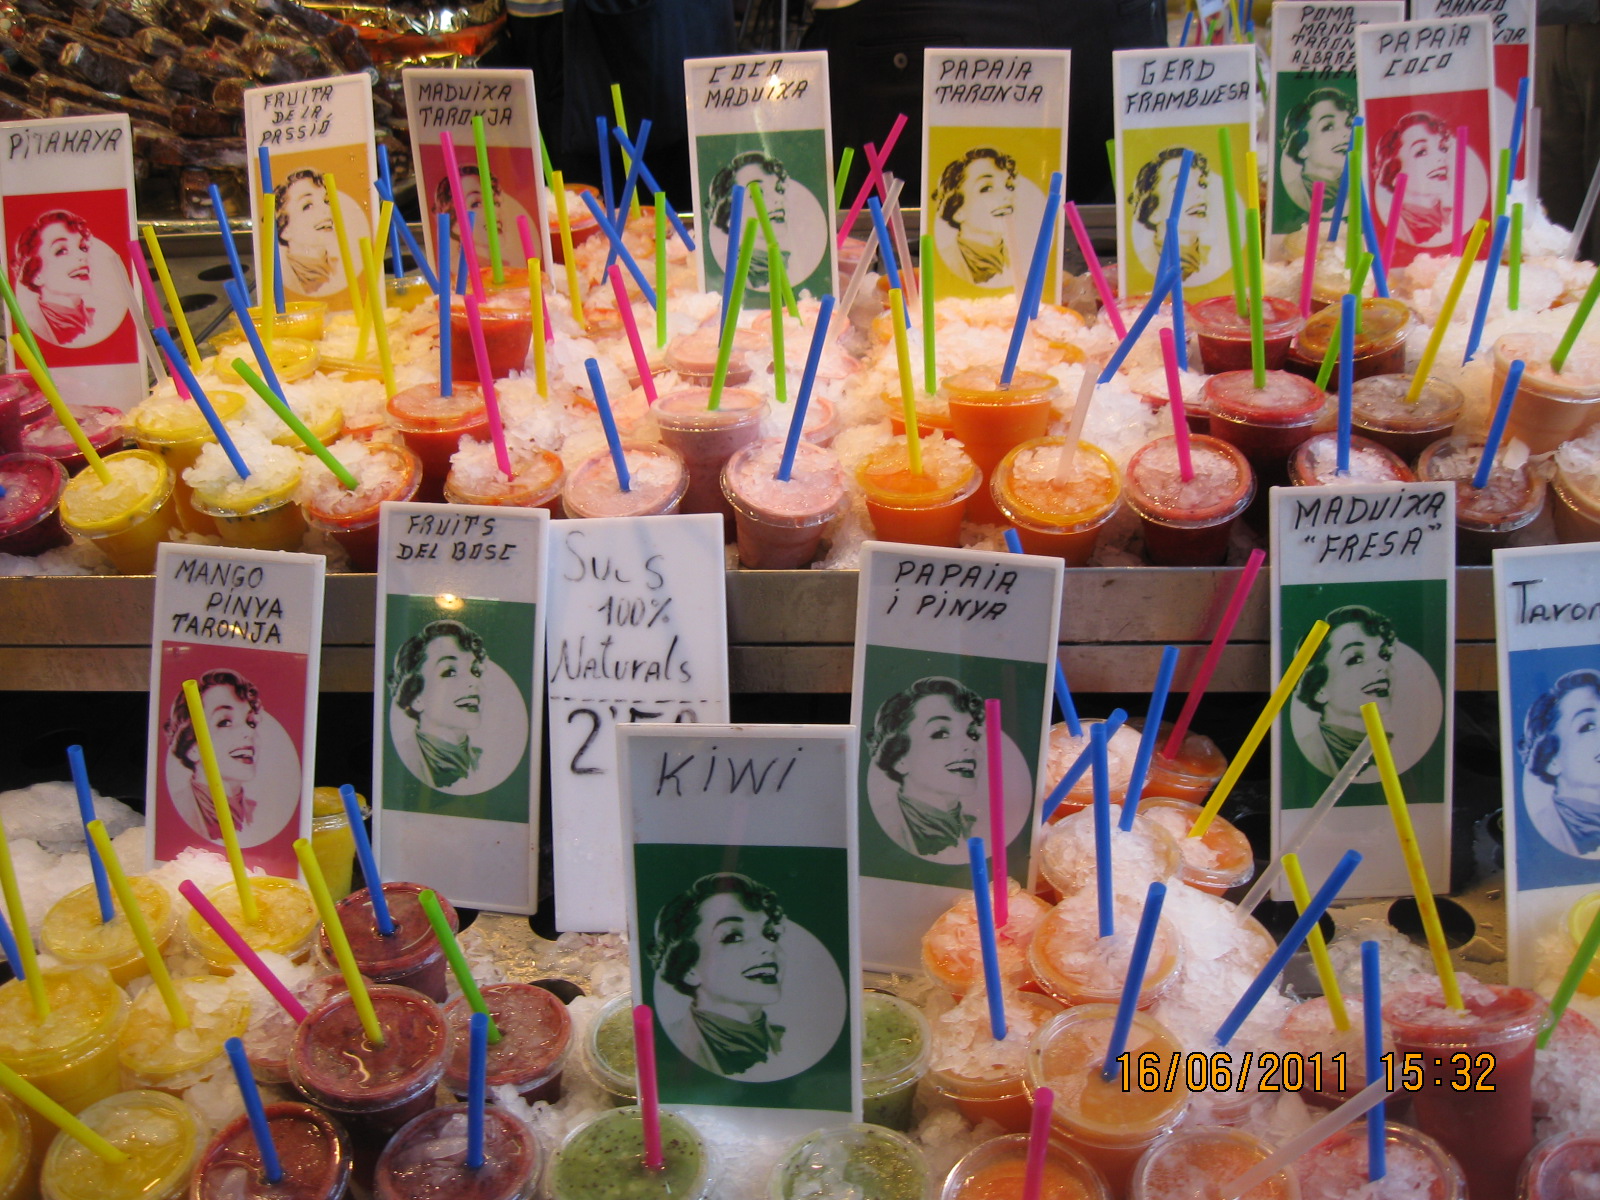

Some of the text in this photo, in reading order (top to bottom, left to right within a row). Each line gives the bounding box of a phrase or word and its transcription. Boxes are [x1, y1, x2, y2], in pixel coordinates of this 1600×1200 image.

[1300, 5, 1354, 22] POMA
[1299, 21, 1369, 36] MANG
[1291, 34, 1355, 50] TARON
[1291, 49, 1356, 65] ALBARE
[1384, 52, 1453, 78] COCO
[1140, 59, 1215, 85] GERD
[935, 83, 1043, 104] TARONJA
[1126, 81, 1250, 114] FRAMBUESA
[271, 110, 295, 124] DE
[396, 541, 517, 561] DEL BOSC
[174, 558, 264, 589] MANGO
[598, 595, 673, 628] 100%
[1511, 578, 1600, 624] Taron
[172, 612, 282, 645] TARONJA
